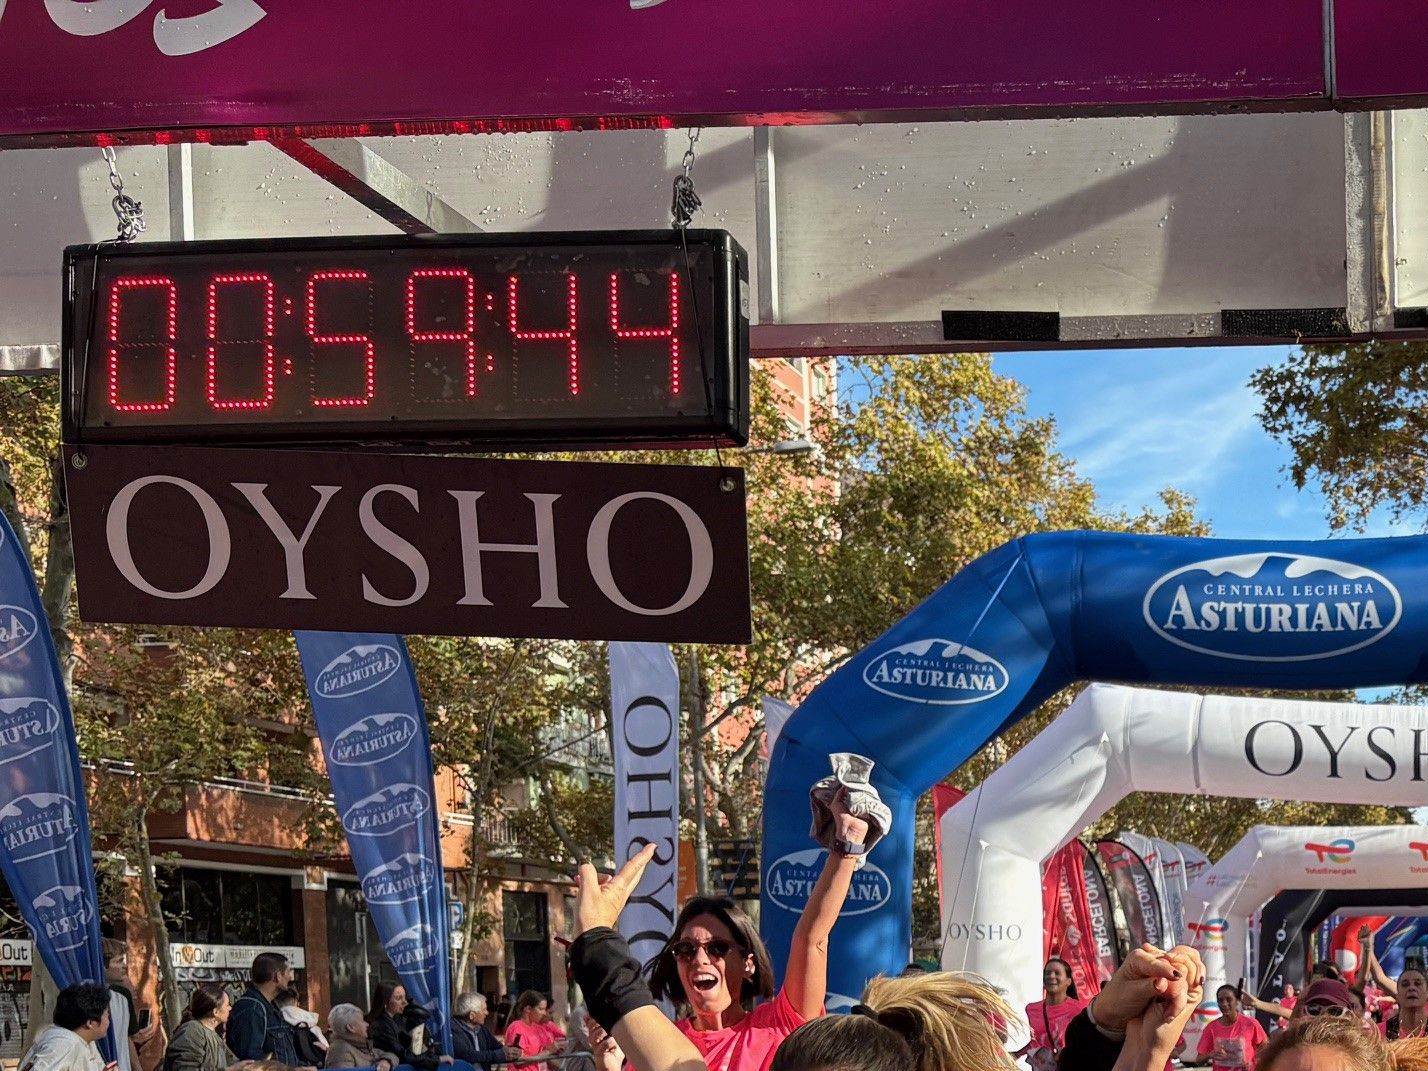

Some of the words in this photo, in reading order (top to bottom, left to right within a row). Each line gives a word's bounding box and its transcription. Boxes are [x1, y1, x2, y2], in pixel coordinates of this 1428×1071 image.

[109, 269, 680, 412] 00:59:44
[105, 474, 714, 617] OYSHO
[1203, 583, 1285, 597] CENTRAL
[1292, 583, 1374, 596] LECHERA
[1163, 584, 1384, 633] ASTURIANA
[871, 659, 997, 691] ASTURIANA
[895, 658, 941, 668] CENTRAL
[945, 662, 994, 673] LECHERA
[771, 870, 882, 901] ASTANA
[949, 922, 1022, 942] OYSHO
[3, 943, 28, 961] Out
[193, 947, 215, 964] Out
